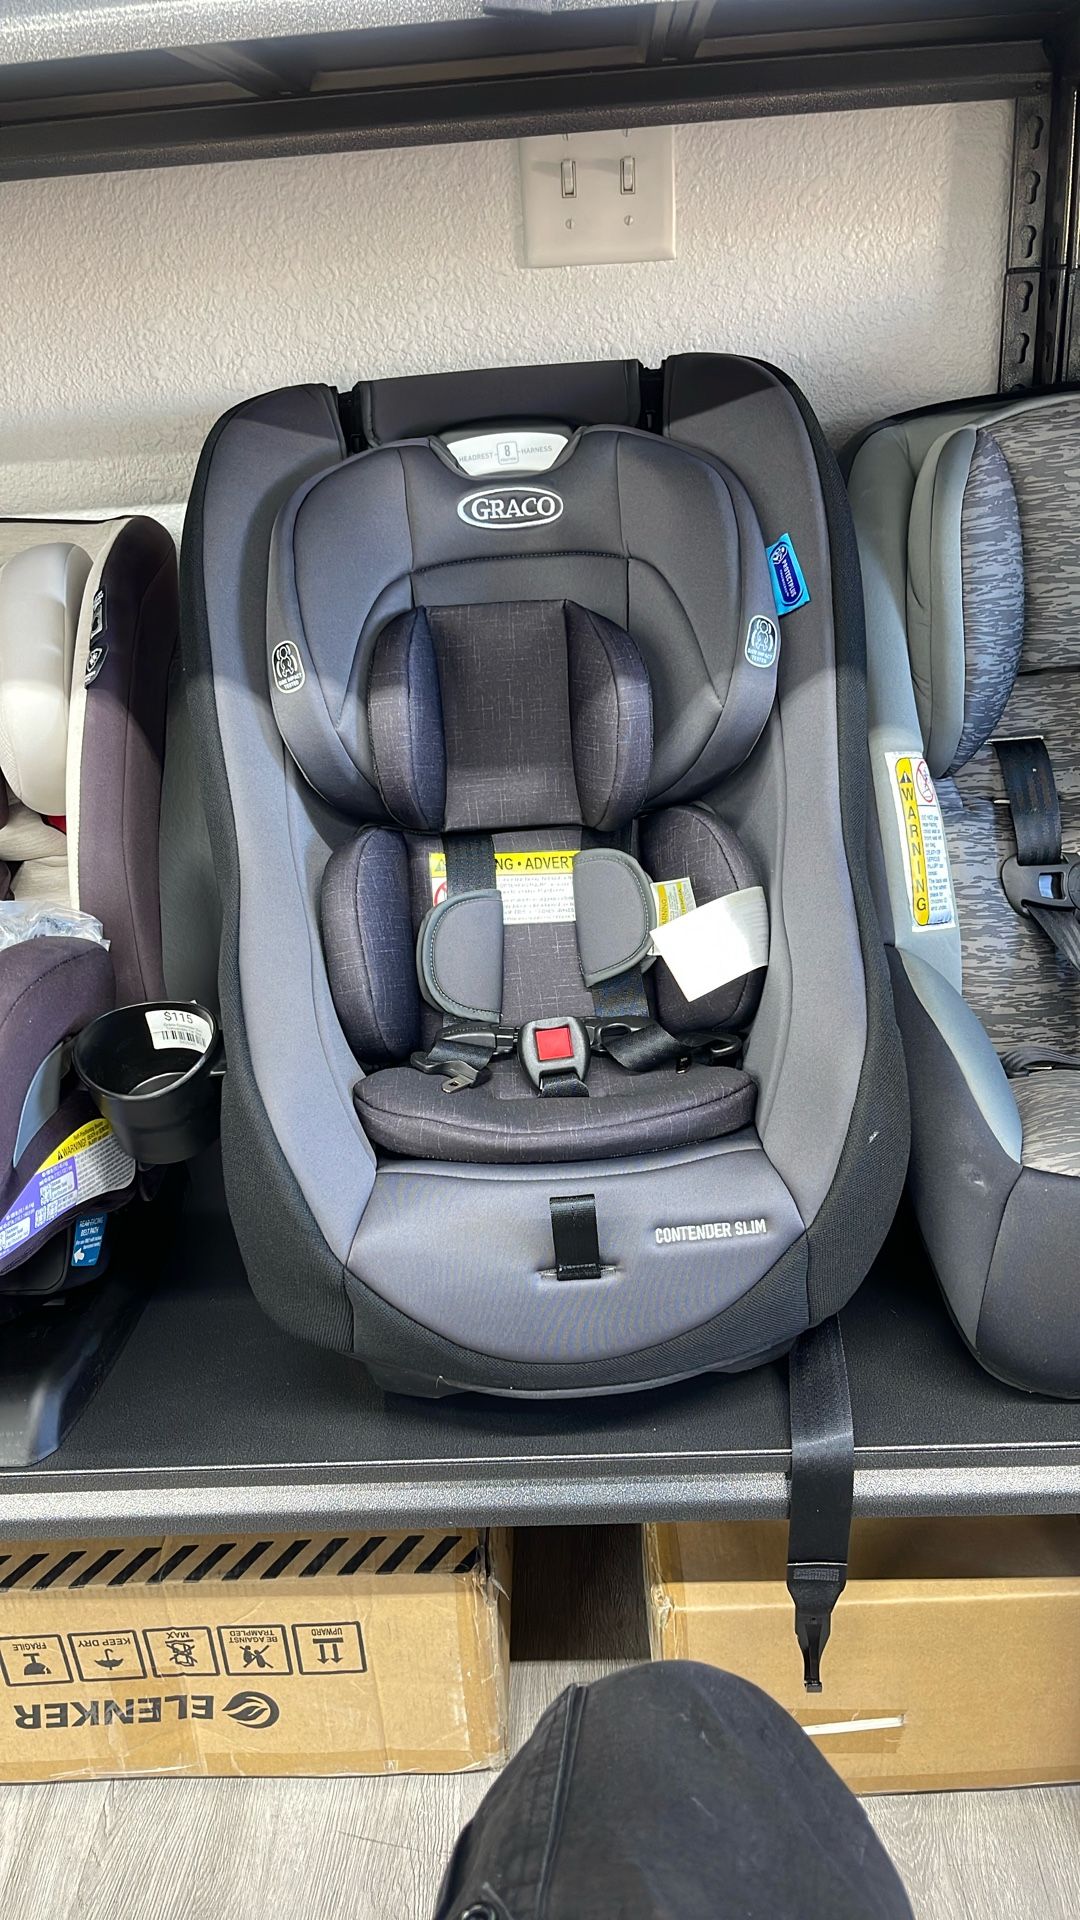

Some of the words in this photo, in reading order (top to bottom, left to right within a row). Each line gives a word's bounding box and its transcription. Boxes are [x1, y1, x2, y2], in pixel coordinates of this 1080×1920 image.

[458, 452, 494, 463] HEADREST
[521, 445, 553, 454] HARNESS
[471, 497, 556, 520] GRACO
[901, 788, 927, 911] WARNING
[655, 1222, 732, 1244] CONTENDER
[734, 1218, 767, 1236] SLIM
[166, 1631, 190, 1639] MAX
[229, 1629, 275, 1637] TRAMPLED
[311, 1627, 343, 1636] UPWARD
[77, 1638, 100, 1648] DRY
[102, 1637, 131, 1646] KEEP
[228, 1636, 263, 1644] AGAINST
[11, 1642, 47, 1651] FRAGILE
[13, 1695, 215, 1730] ELENKER
